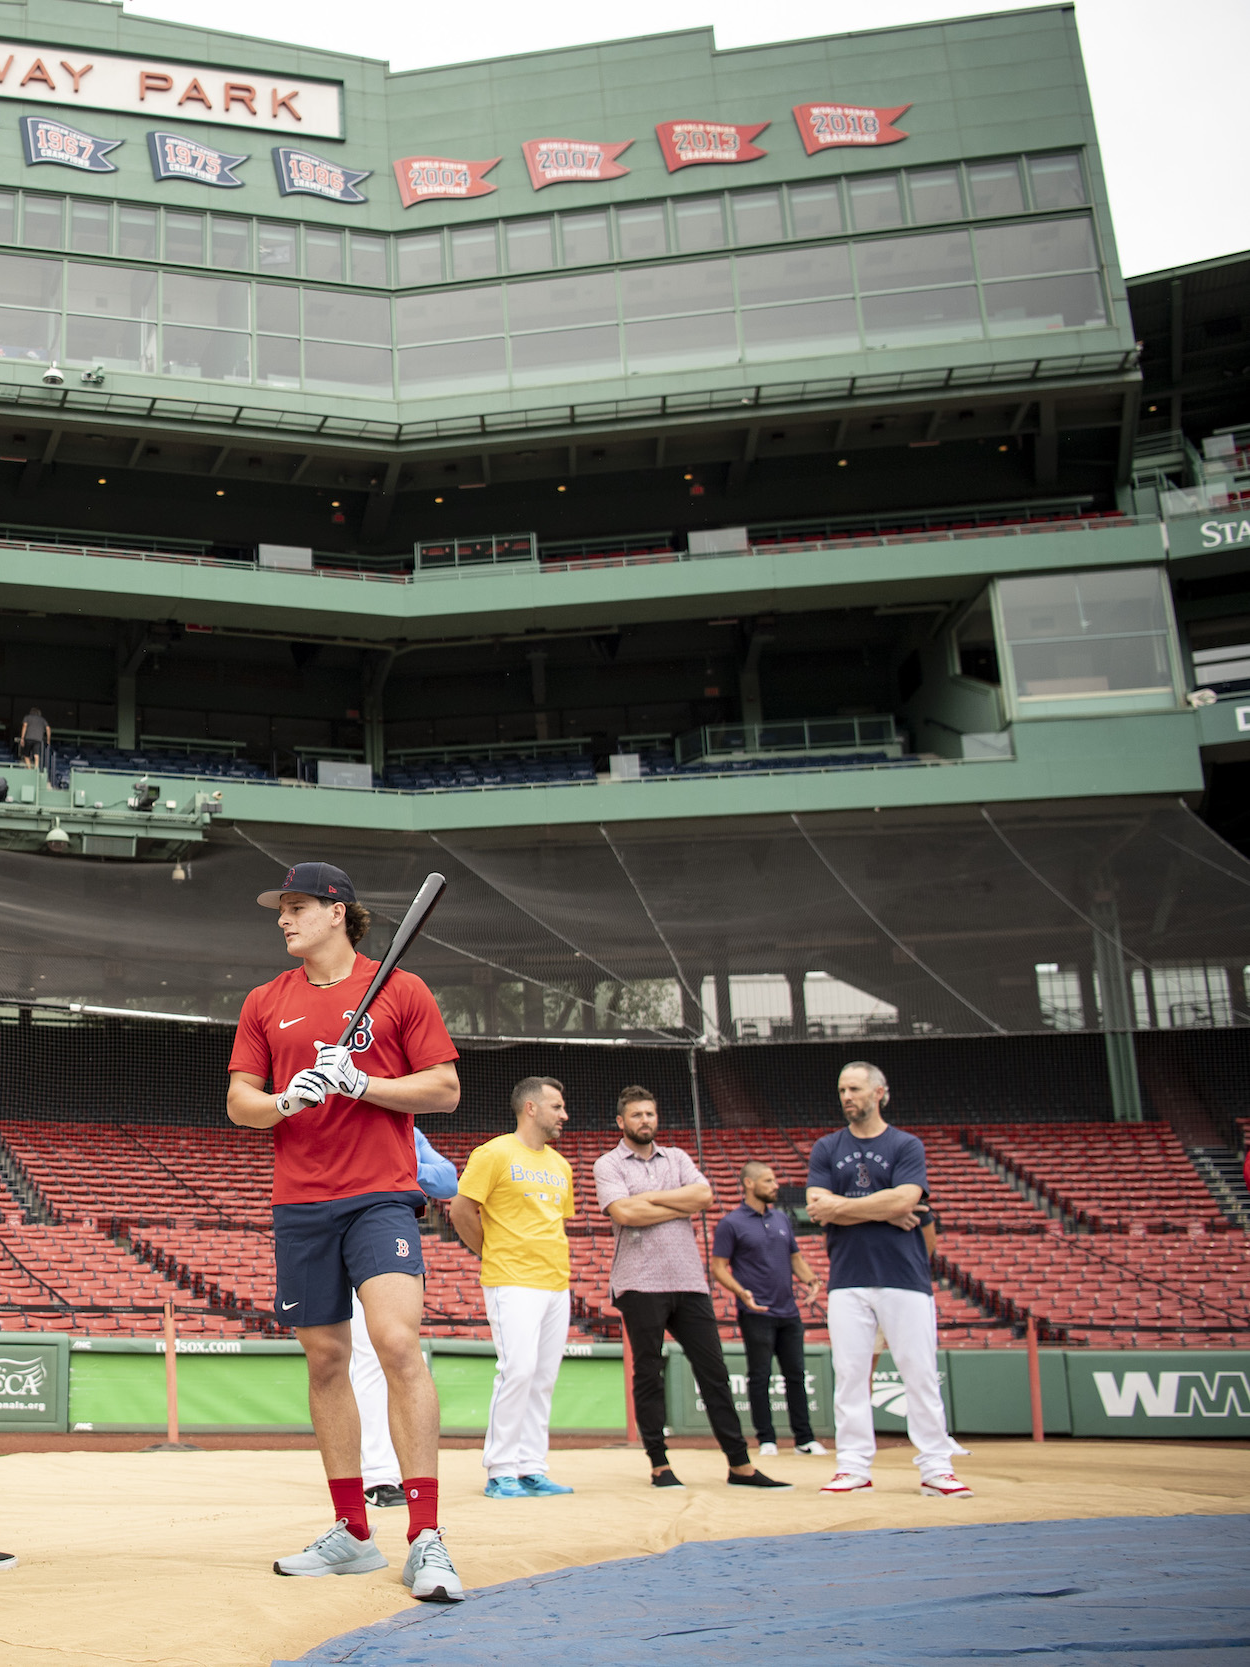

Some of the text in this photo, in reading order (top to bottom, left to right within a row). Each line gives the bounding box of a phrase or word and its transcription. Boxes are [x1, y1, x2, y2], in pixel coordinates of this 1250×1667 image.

[139, 71, 301, 121] PARK
[810, 114, 879, 135] 2018
[36, 128, 95, 160] 1967
[673, 131, 740, 151] 2013
[818, 132, 877, 144] CHAMPIONS
[164, 143, 221, 175] 1975
[536, 150, 604, 171] 2007
[681, 149, 737, 161] CHAMPIONS
[288, 159, 345, 191] 1986
[409, 168, 471, 188] 2004
[342, 1010, 374, 1053] B
[865, 1151, 890, 1170] SOX
[510, 1164, 568, 1189] Boston
[395, 1237, 410, 1258] B
[1092, 1371, 1250, 1417] WM
